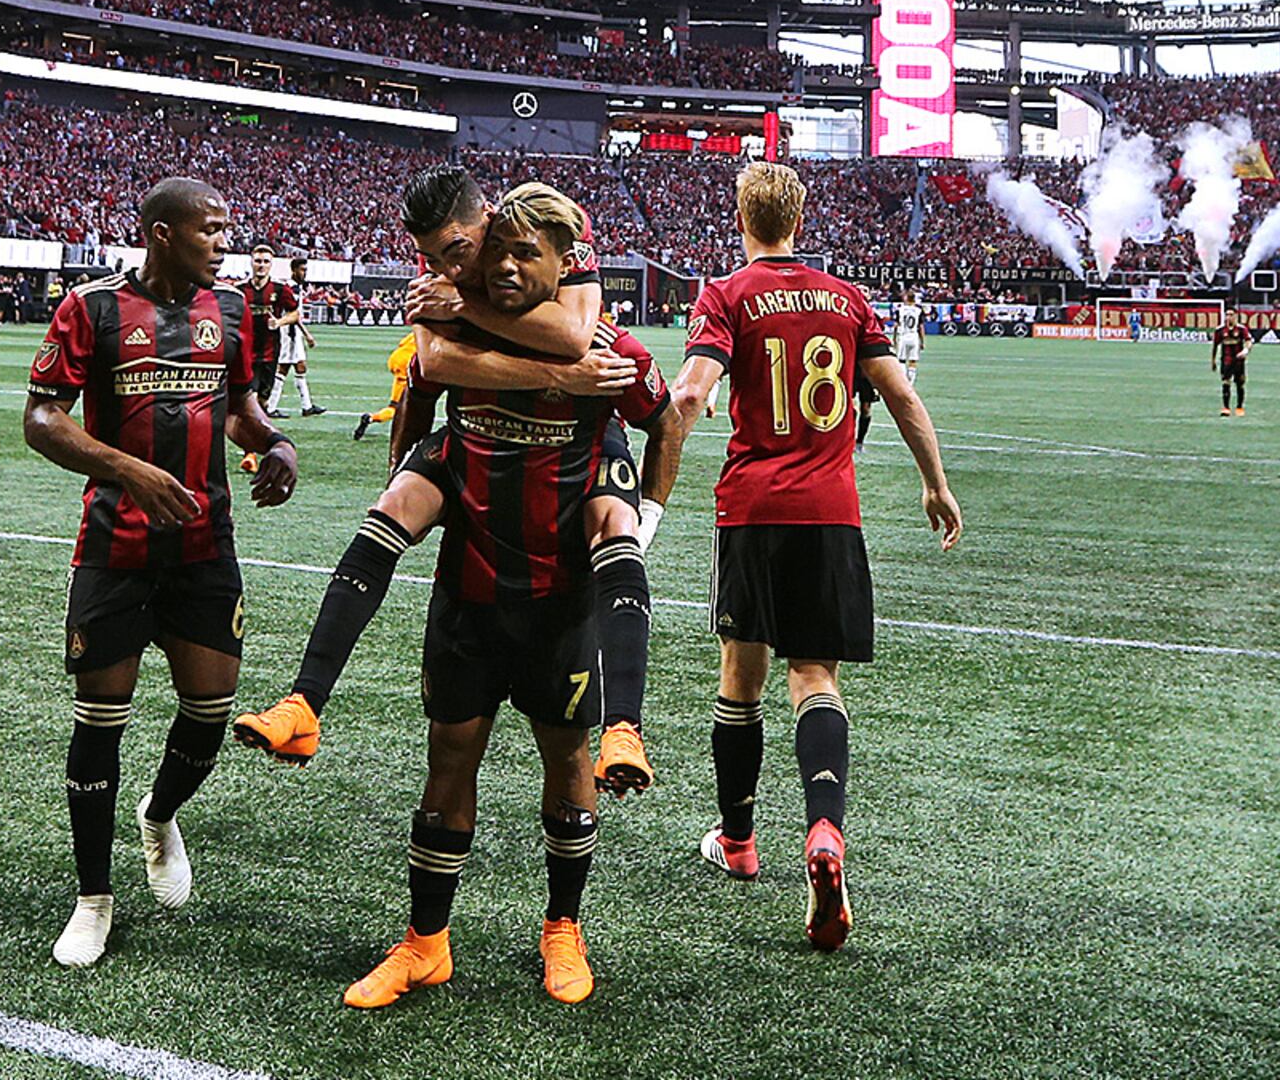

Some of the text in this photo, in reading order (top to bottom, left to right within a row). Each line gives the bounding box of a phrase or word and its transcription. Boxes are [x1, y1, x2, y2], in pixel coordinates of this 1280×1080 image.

[1130, 14, 1238, 31] Mercedes-Benz
[837, 266, 947, 281] RESURGENCE
[983, 269, 1027, 280] ROWDY
[604, 277, 637, 291] UNITED
[743, 289, 850, 321] LARENTOWICZ
[903, 314, 916, 329] 10
[1140, 327, 1208, 341] Heineken
[115, 370, 222, 383] AMERICAN FAMILY
[765, 335, 847, 435] 18
[527, 424, 576, 437] FAMILY
[597, 458, 636, 491] 10
[232, 594, 245, 640] 6
[564, 671, 590, 720] 7
